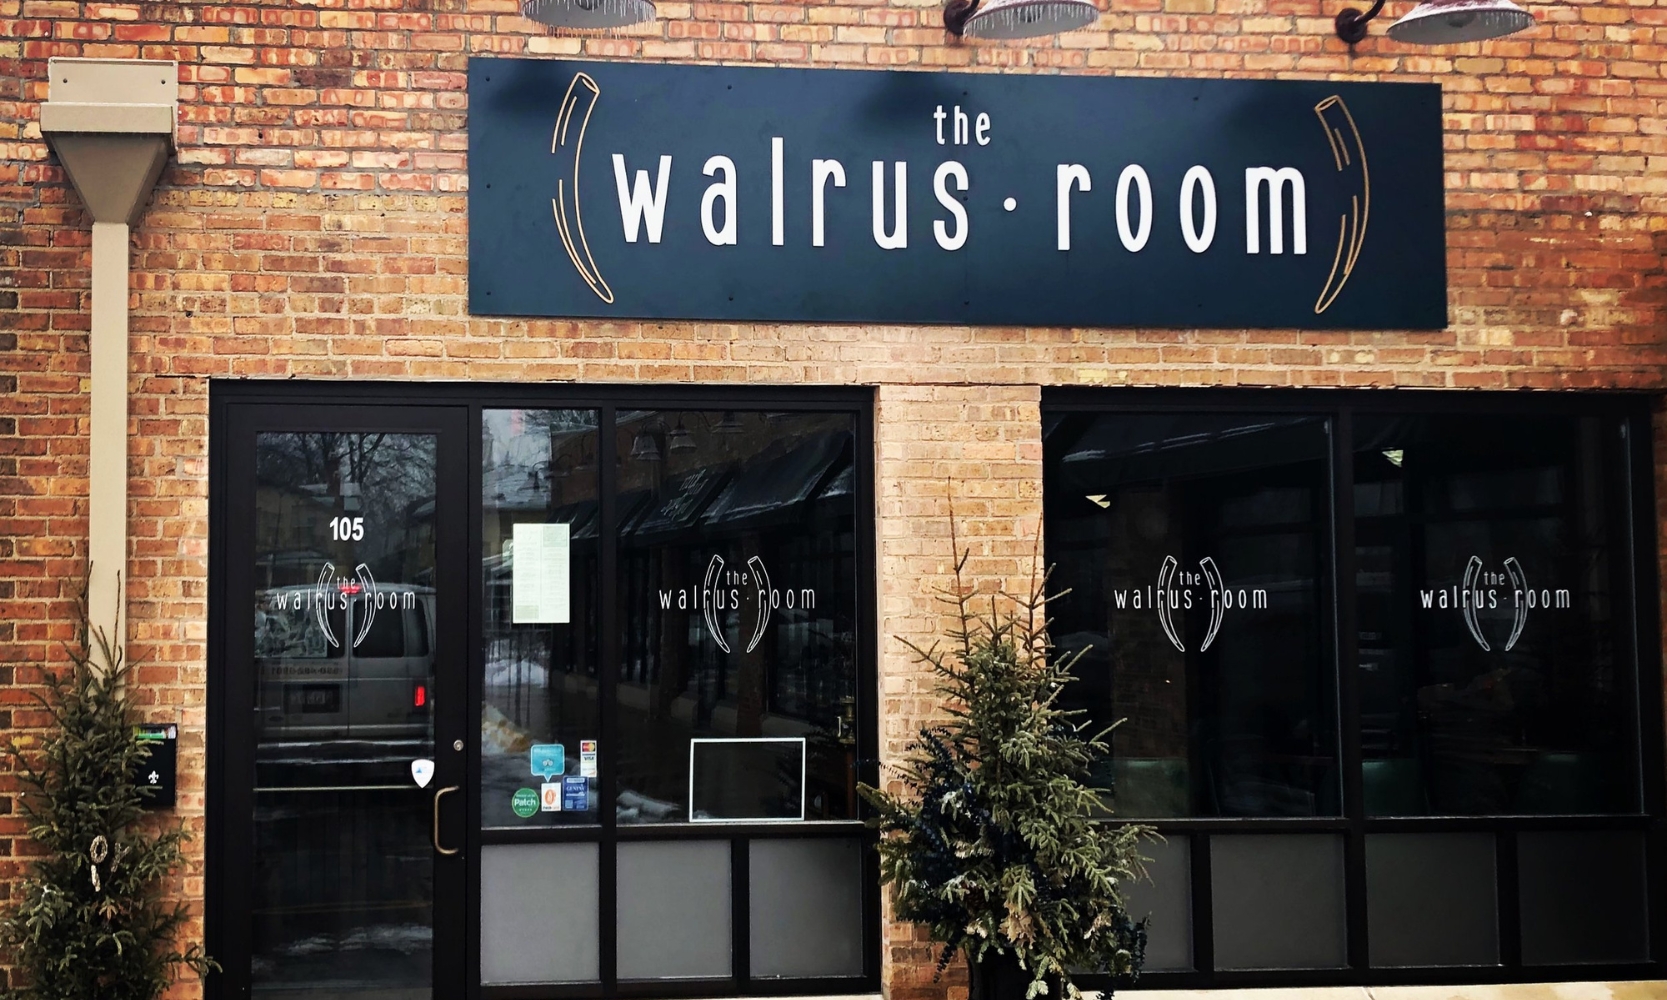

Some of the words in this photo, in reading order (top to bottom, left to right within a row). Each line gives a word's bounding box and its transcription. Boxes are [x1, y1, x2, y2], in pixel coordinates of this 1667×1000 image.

[934, 105, 991, 146] the
[612, 137, 969, 251] walrus
[1056, 163, 1307, 255] room
[329, 516, 364, 541] 105
[336, 576, 356, 589] the
[726, 570, 748, 586] the
[1179, 571, 1201, 586] the
[1483, 571, 1505, 586] the
[277, 588, 348, 610] walrus
[364, 591, 416, 610] room
[659, 584, 740, 610] walrus
[758, 588, 815, 610] room
[1114, 584, 1193, 610] walrus
[1211, 588, 1268, 610] room
[1420, 585, 1498, 610] walrus
[1514, 588, 1571, 610] room
[514, 798, 536, 807] Patch
